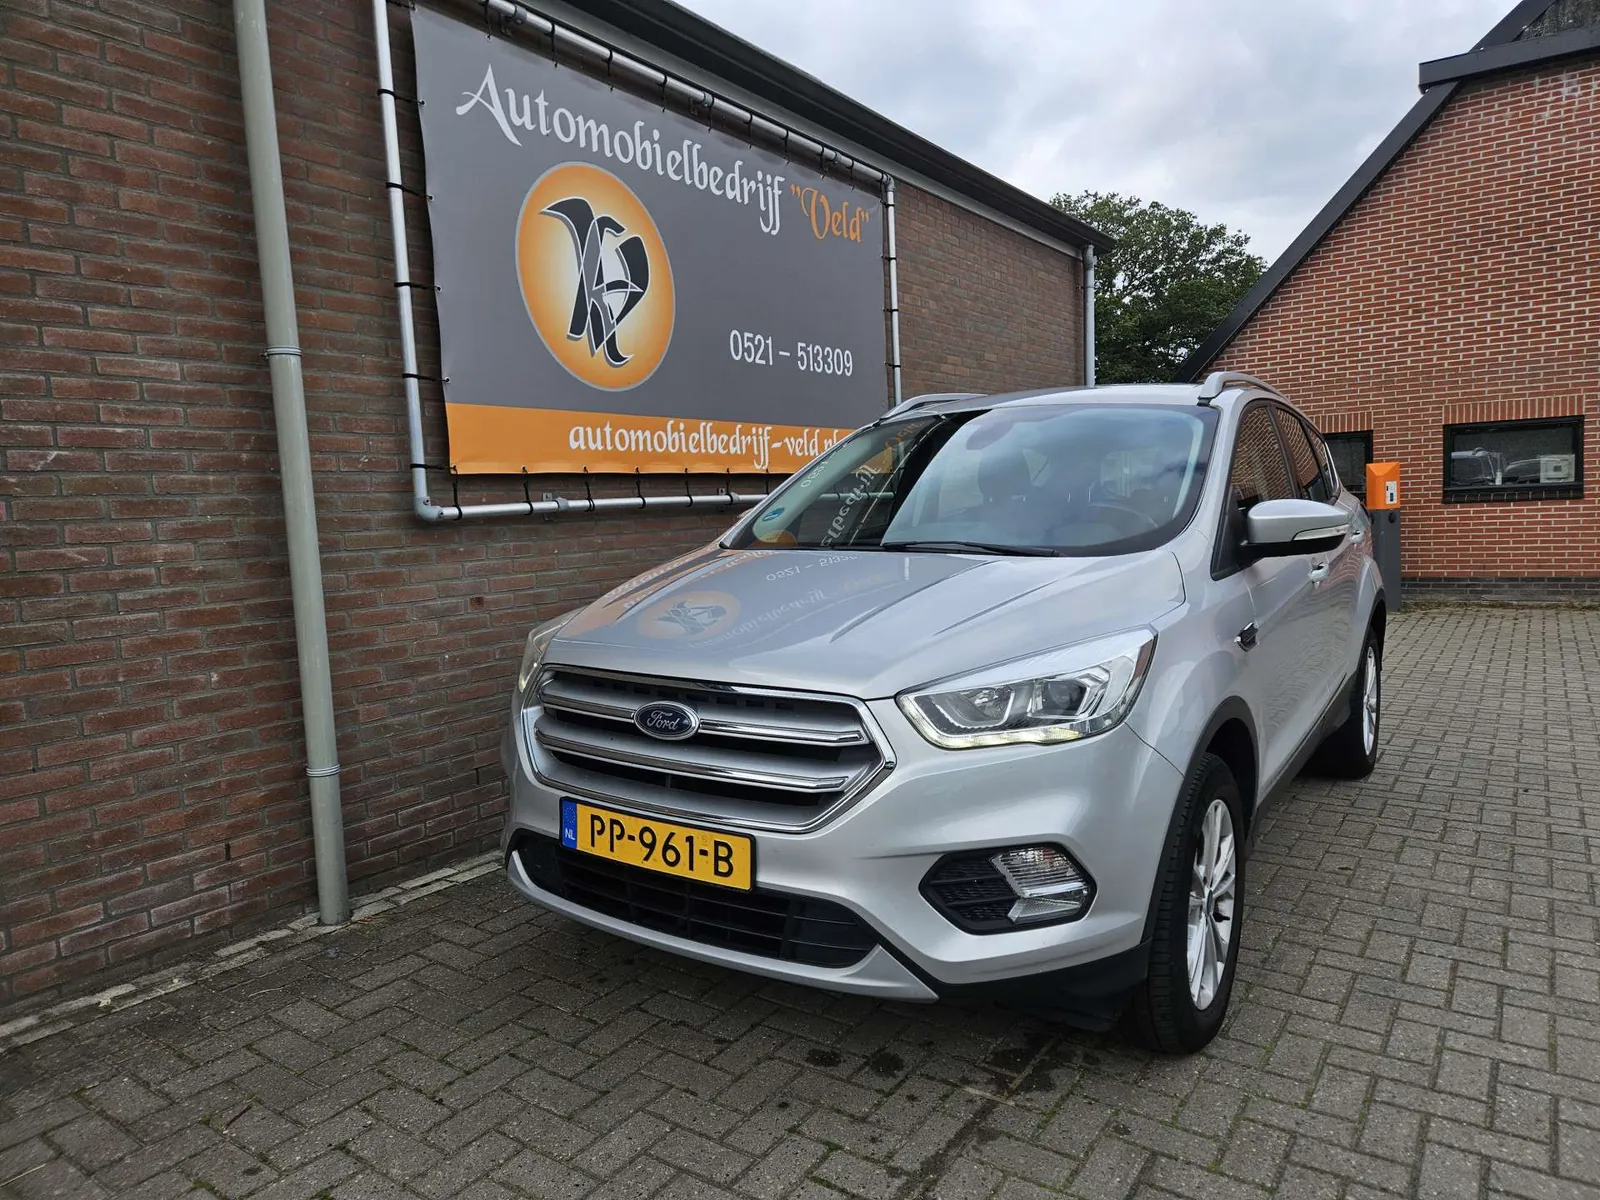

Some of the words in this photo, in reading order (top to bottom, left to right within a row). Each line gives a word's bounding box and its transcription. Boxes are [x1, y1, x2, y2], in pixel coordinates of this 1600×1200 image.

[455, 63, 785, 236] Automobielbedrijf
[730, 329, 774, 366] 0521
[797, 342, 853, 377] 513309
[646, 709, 681, 732] Ford
[564, 828, 576, 841] NL
[590, 813, 734, 879] PP-961-B
